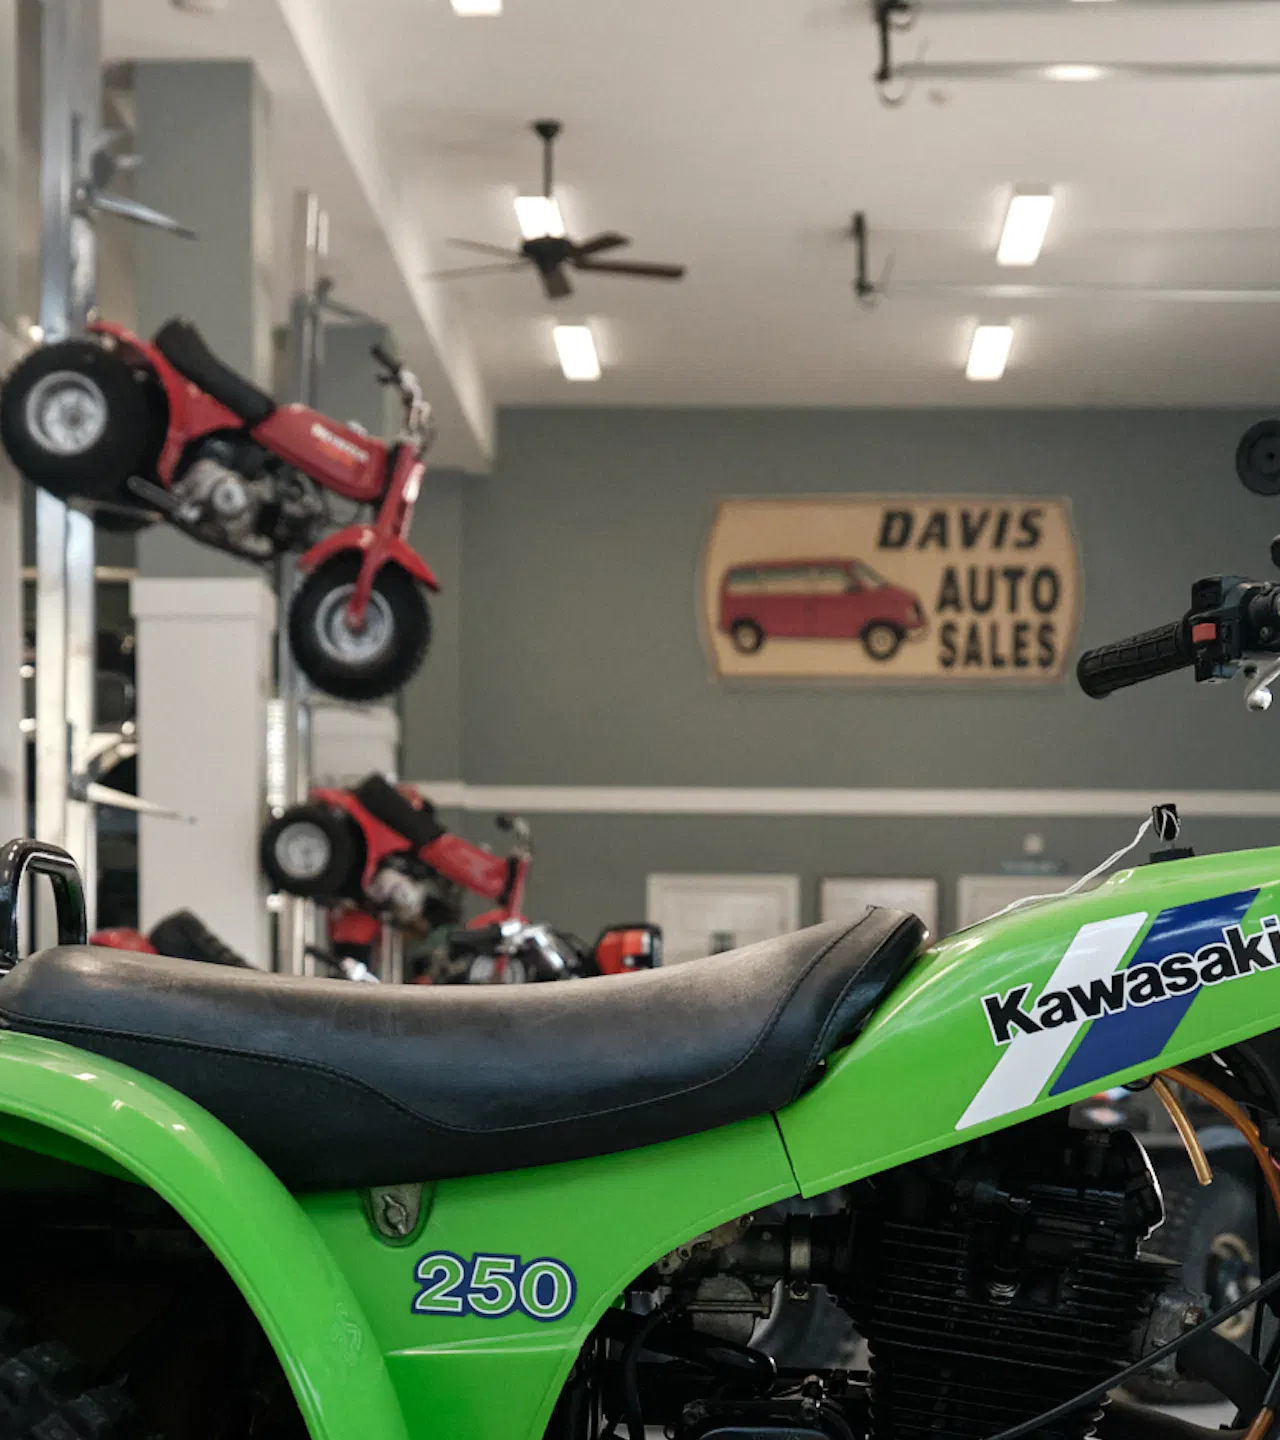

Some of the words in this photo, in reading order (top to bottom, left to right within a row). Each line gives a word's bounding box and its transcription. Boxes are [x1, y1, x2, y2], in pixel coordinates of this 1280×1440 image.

[876, 508, 1046, 551] DAVIS
[935, 565, 1062, 615] AUTO
[937, 620, 1058, 668] SALES
[412, 1251, 577, 1322] 250
